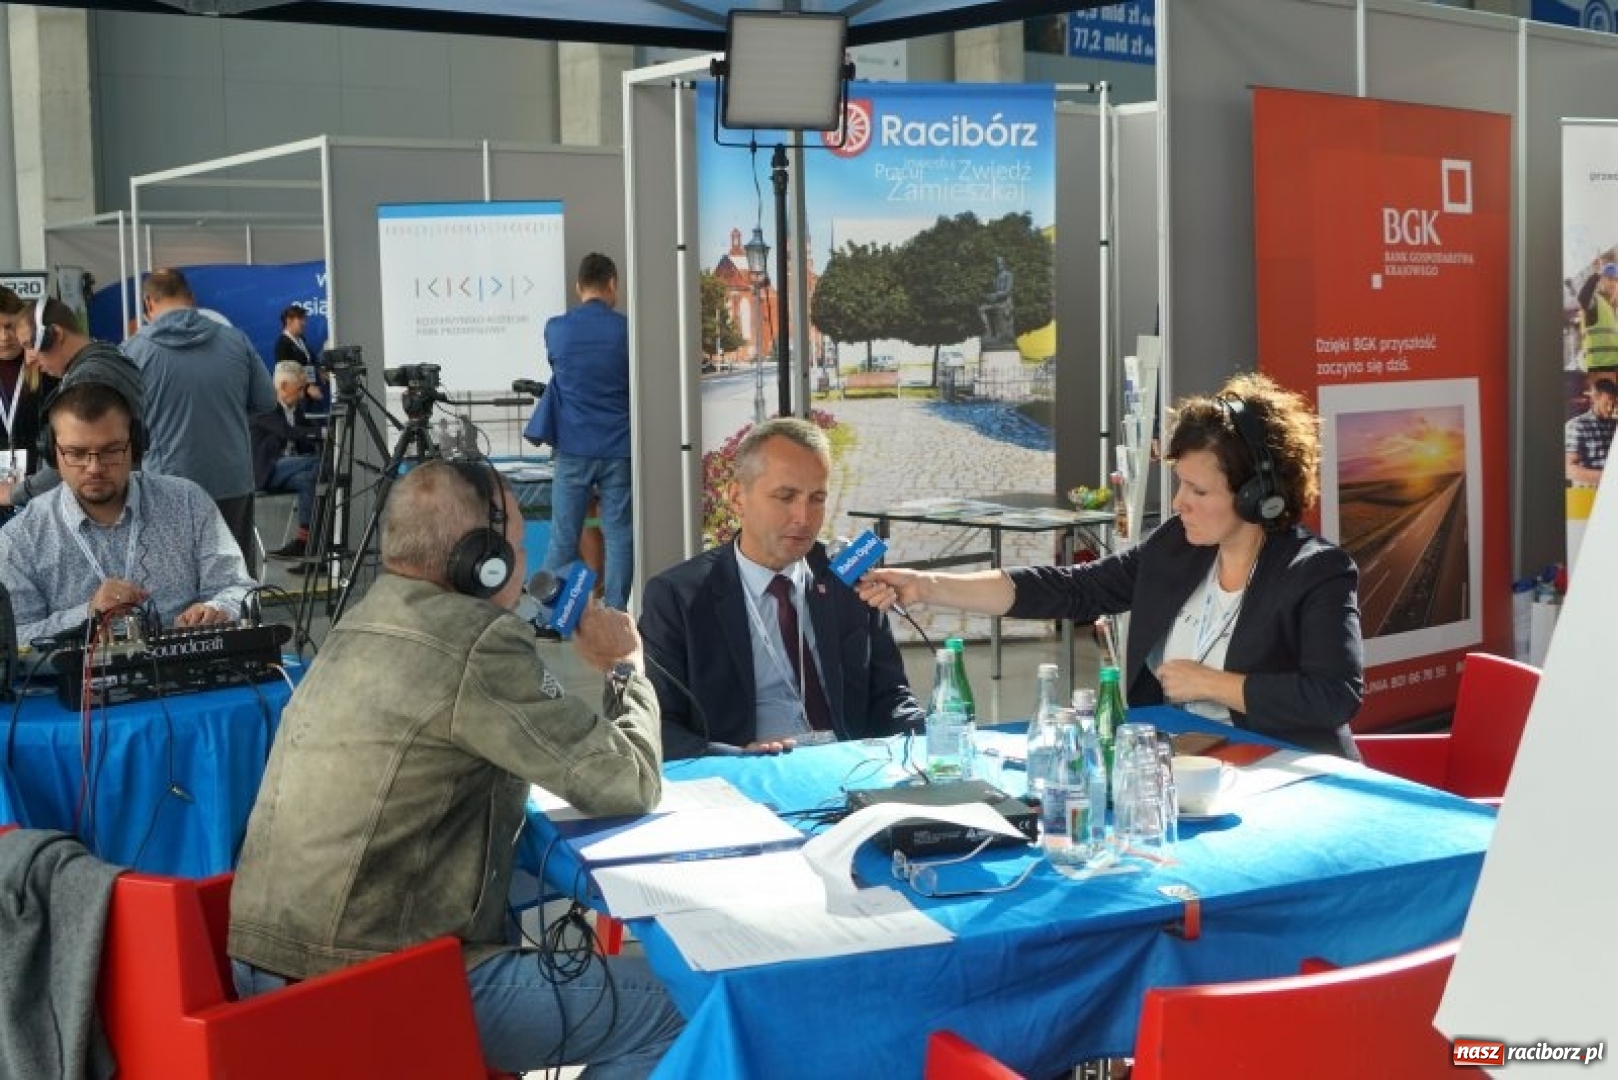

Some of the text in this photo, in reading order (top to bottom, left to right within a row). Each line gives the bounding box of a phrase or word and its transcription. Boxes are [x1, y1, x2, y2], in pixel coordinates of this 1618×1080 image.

[1073, 26, 1101, 53] 77,2
[1103, 31, 1129, 54] mld
[881, 112, 1038, 147] Racibórz
[1382, 207, 1442, 246] BGK
[1316, 333, 1437, 355] Dzięki BGK przyszłość
[1316, 361, 1364, 379] zaczyna
[1366, 358, 1382, 375] się
